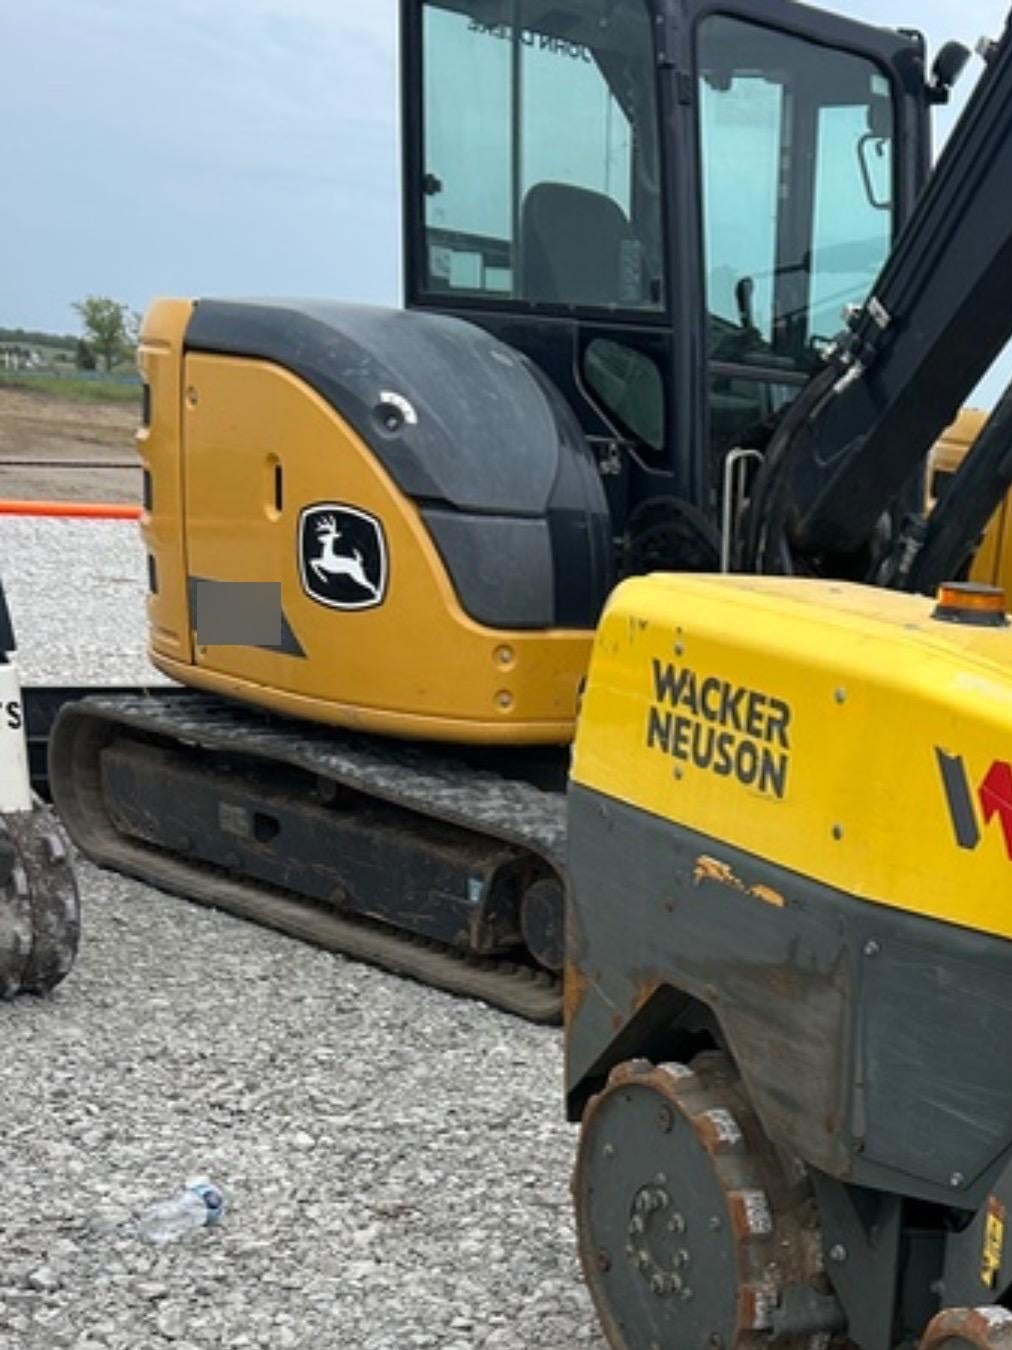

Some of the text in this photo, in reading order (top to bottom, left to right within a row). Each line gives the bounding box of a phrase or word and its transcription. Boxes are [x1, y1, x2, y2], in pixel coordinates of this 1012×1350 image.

[0, 701, 21, 730] S
[652, 657, 791, 750] WACKER
[646, 706, 788, 799] NEUSON
